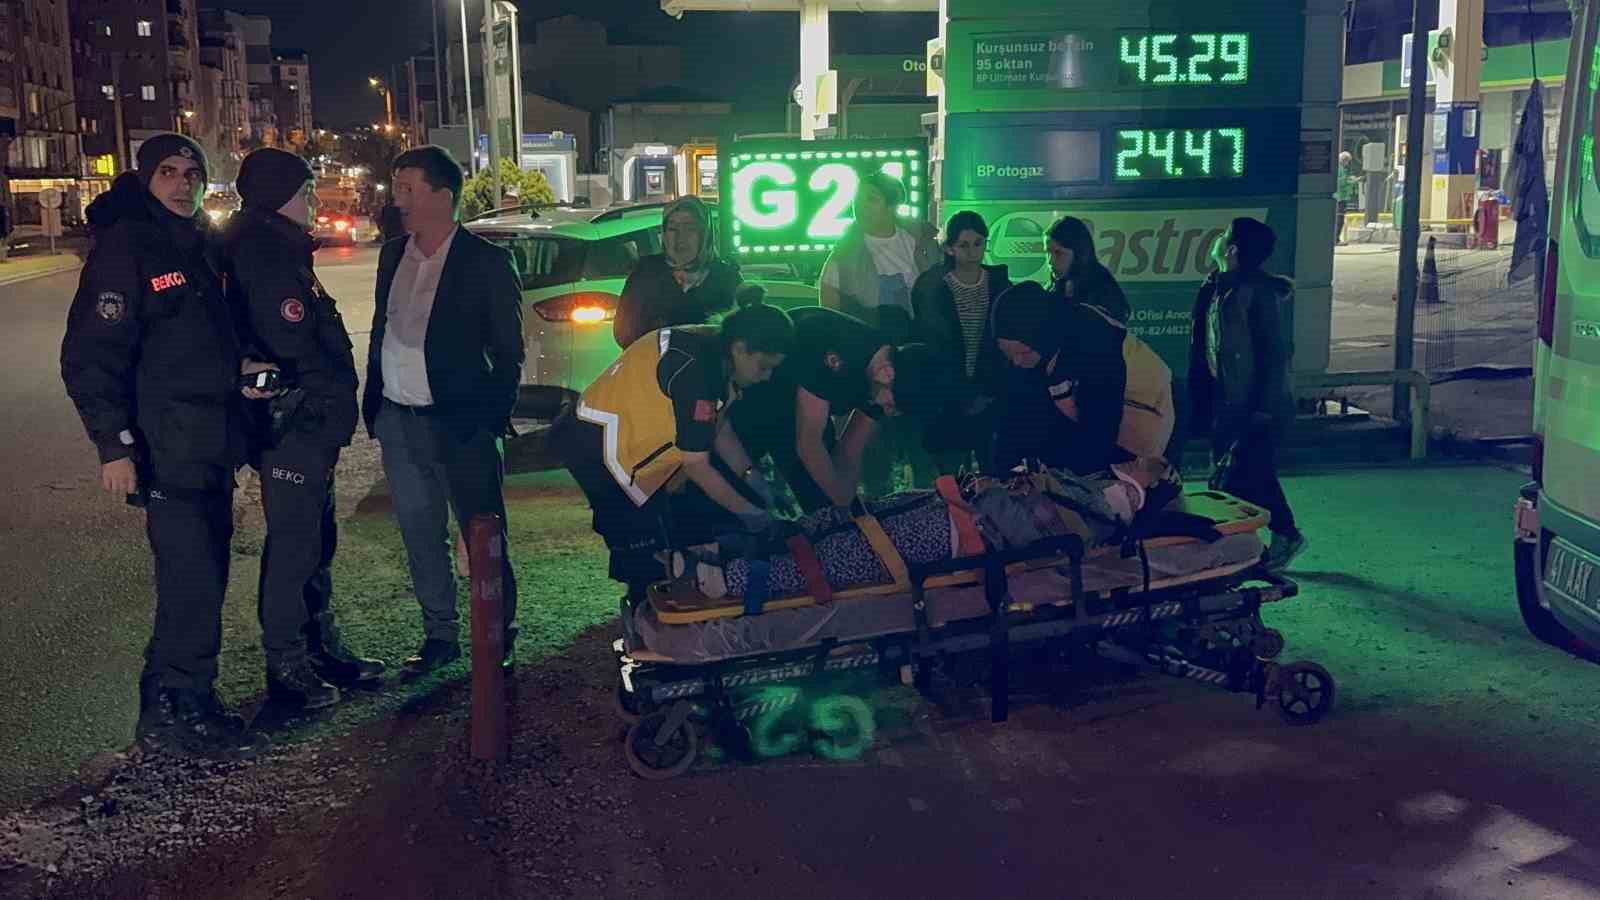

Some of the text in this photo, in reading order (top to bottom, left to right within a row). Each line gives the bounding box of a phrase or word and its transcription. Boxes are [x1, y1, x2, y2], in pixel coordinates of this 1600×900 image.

[976, 39, 1094, 56] Kurşunsuz bein
[1120, 34, 1247, 82] 45.29
[976, 58, 1032, 70] 95 oktan
[1116, 129, 1244, 177] 24.47
[977, 165, 1044, 179] BP otogaz
[1083, 217, 1225, 275] astro
